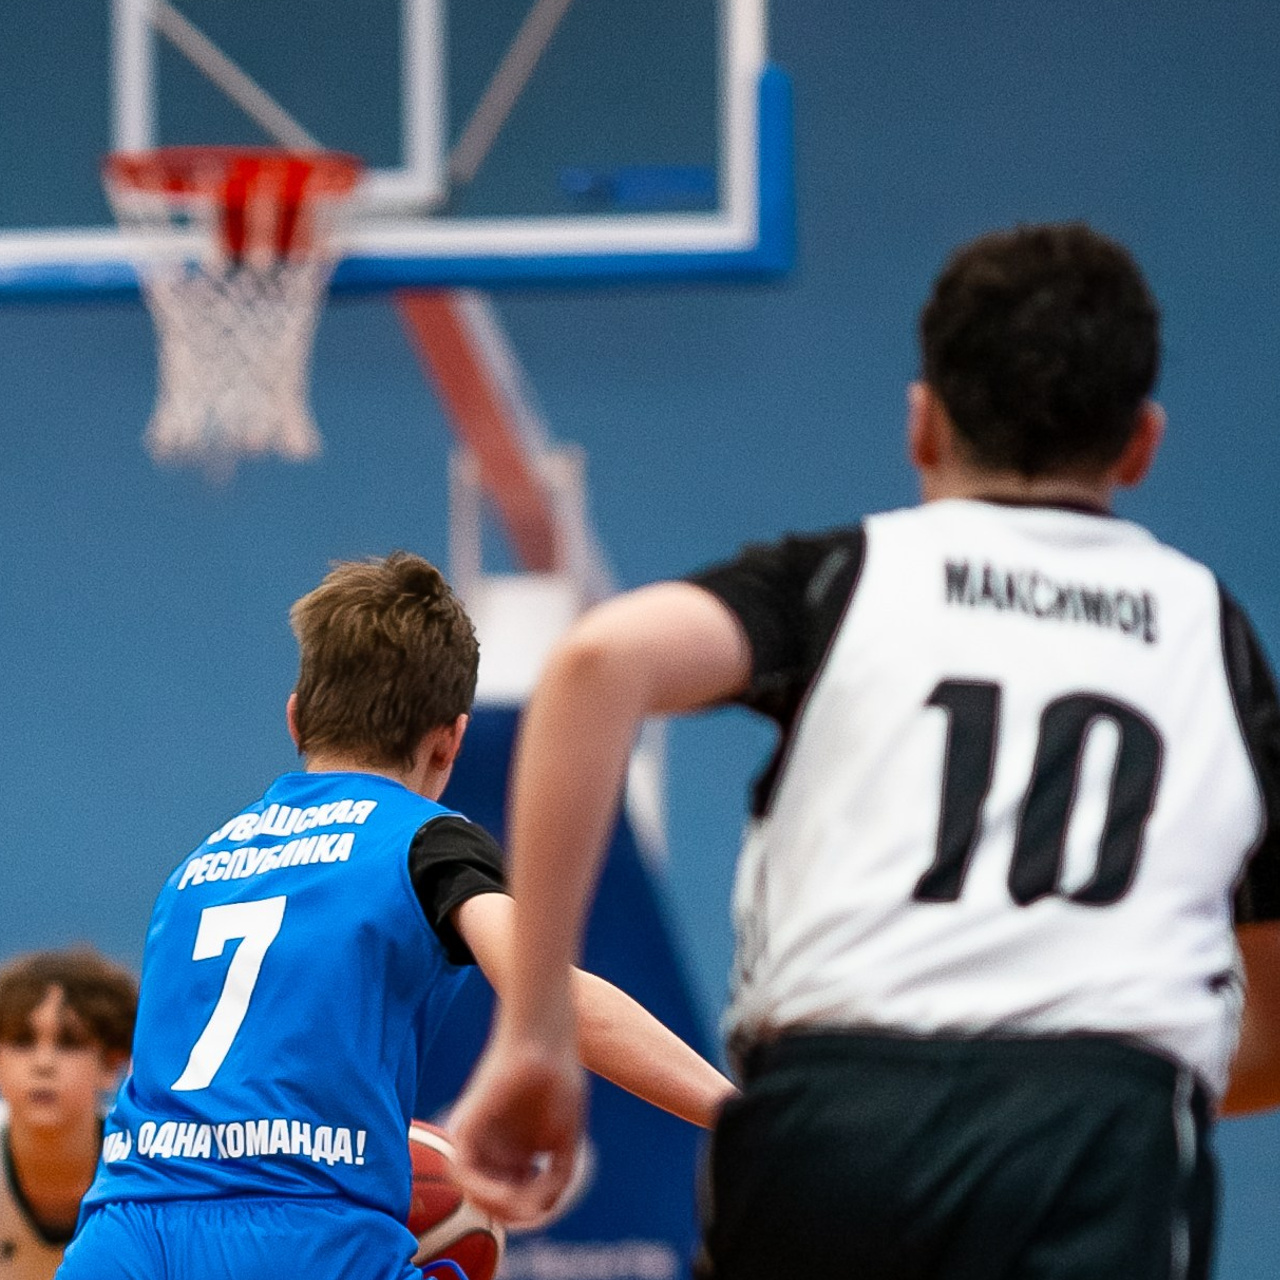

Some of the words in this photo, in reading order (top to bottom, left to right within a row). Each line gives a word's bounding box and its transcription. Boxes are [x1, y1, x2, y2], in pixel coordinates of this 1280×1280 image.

[913, 676, 1165, 908] 10
[176, 832, 356, 891] РЕСПУБЛИКА
[170, 895, 287, 1091] 7
[137, 1120, 212, 1159] ОДНА
